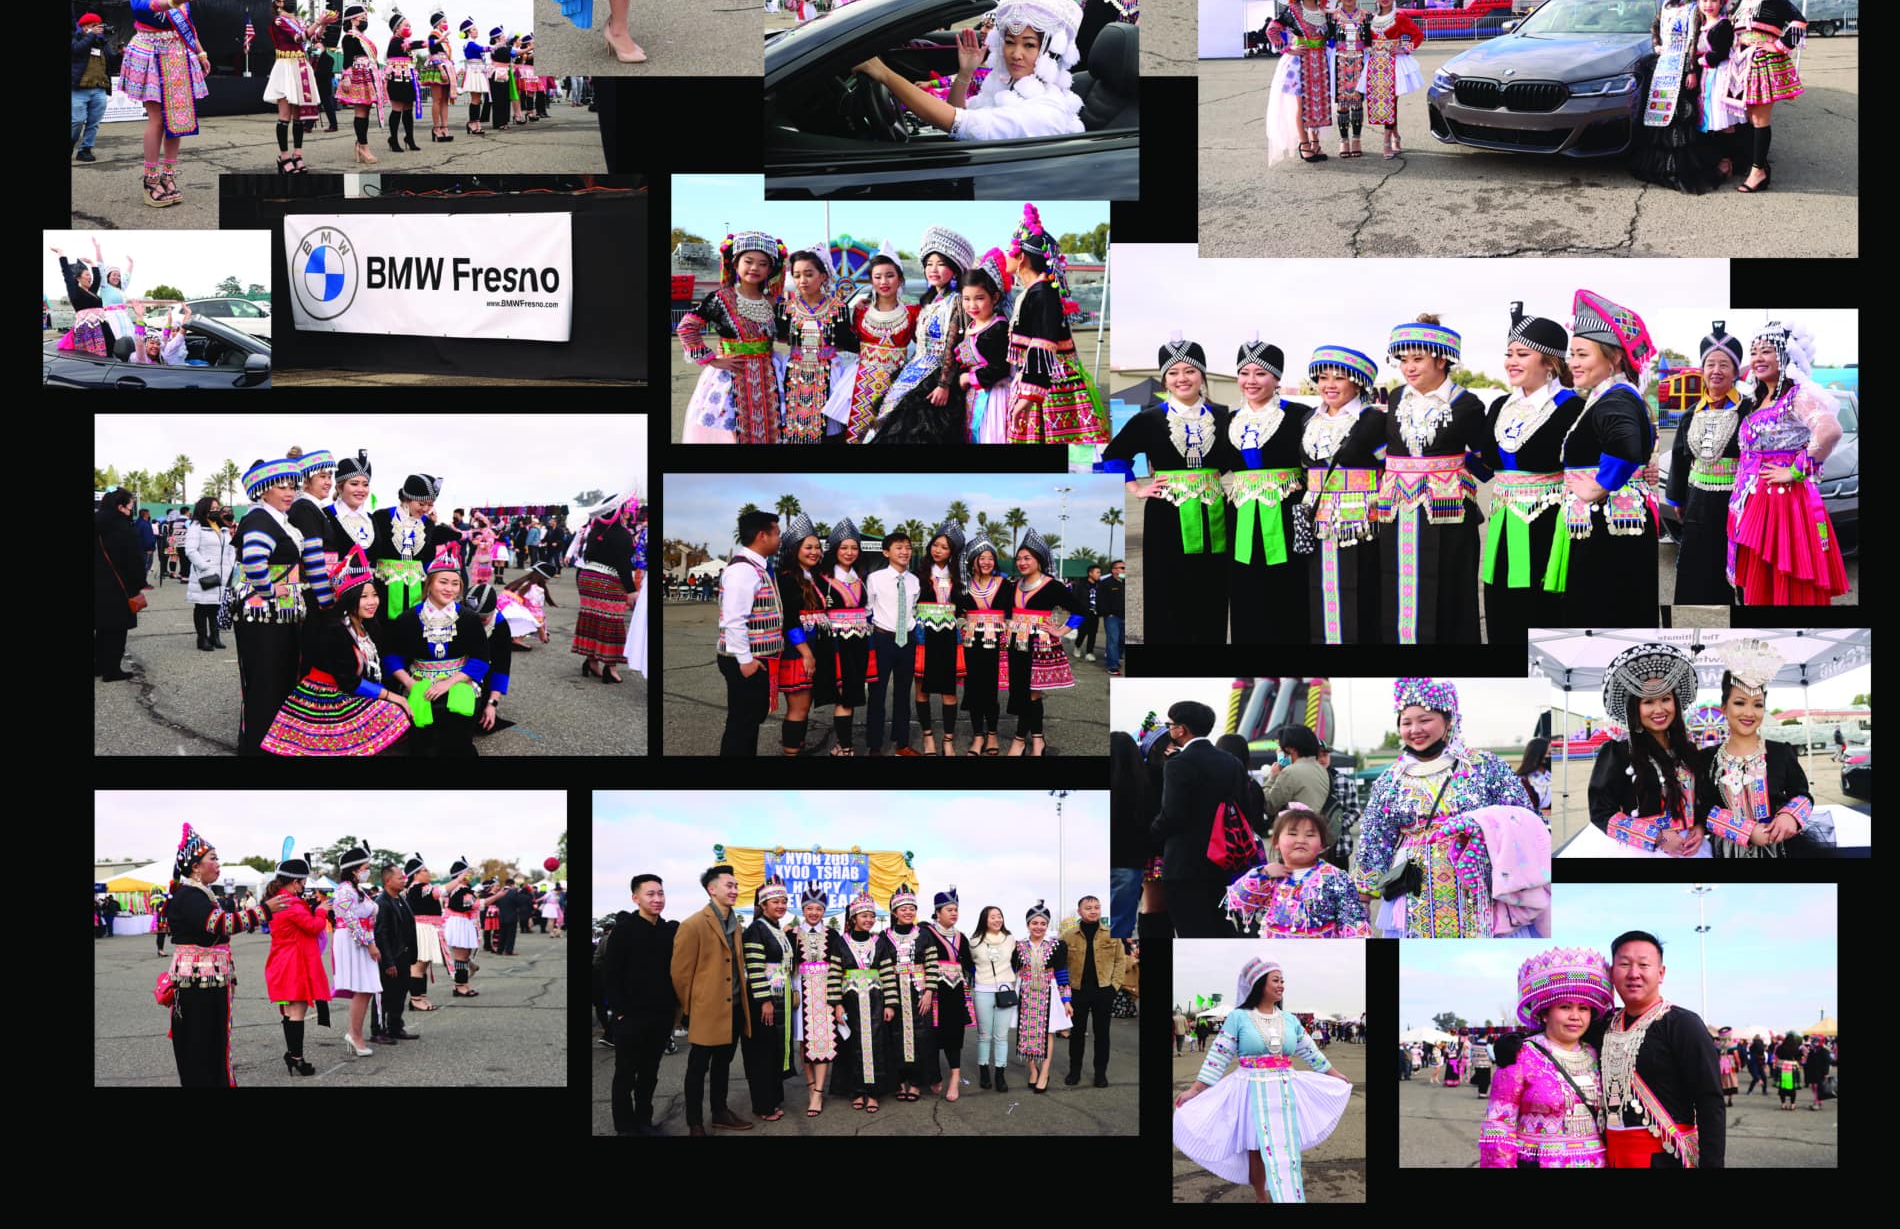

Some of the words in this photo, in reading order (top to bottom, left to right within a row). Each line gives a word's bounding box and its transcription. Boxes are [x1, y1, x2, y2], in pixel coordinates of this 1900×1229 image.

[303, 232, 350, 257] BMW
[366, 256, 444, 291] BMW
[453, 257, 560, 294] Fresno
[486, 299, 559, 309] www.BMWFresno.com
[785, 852, 820, 866] NYOB
[824, 853, 849, 866] ZOO
[816, 865, 860, 880] TSHAB
[793, 880, 842, 894] HPY
